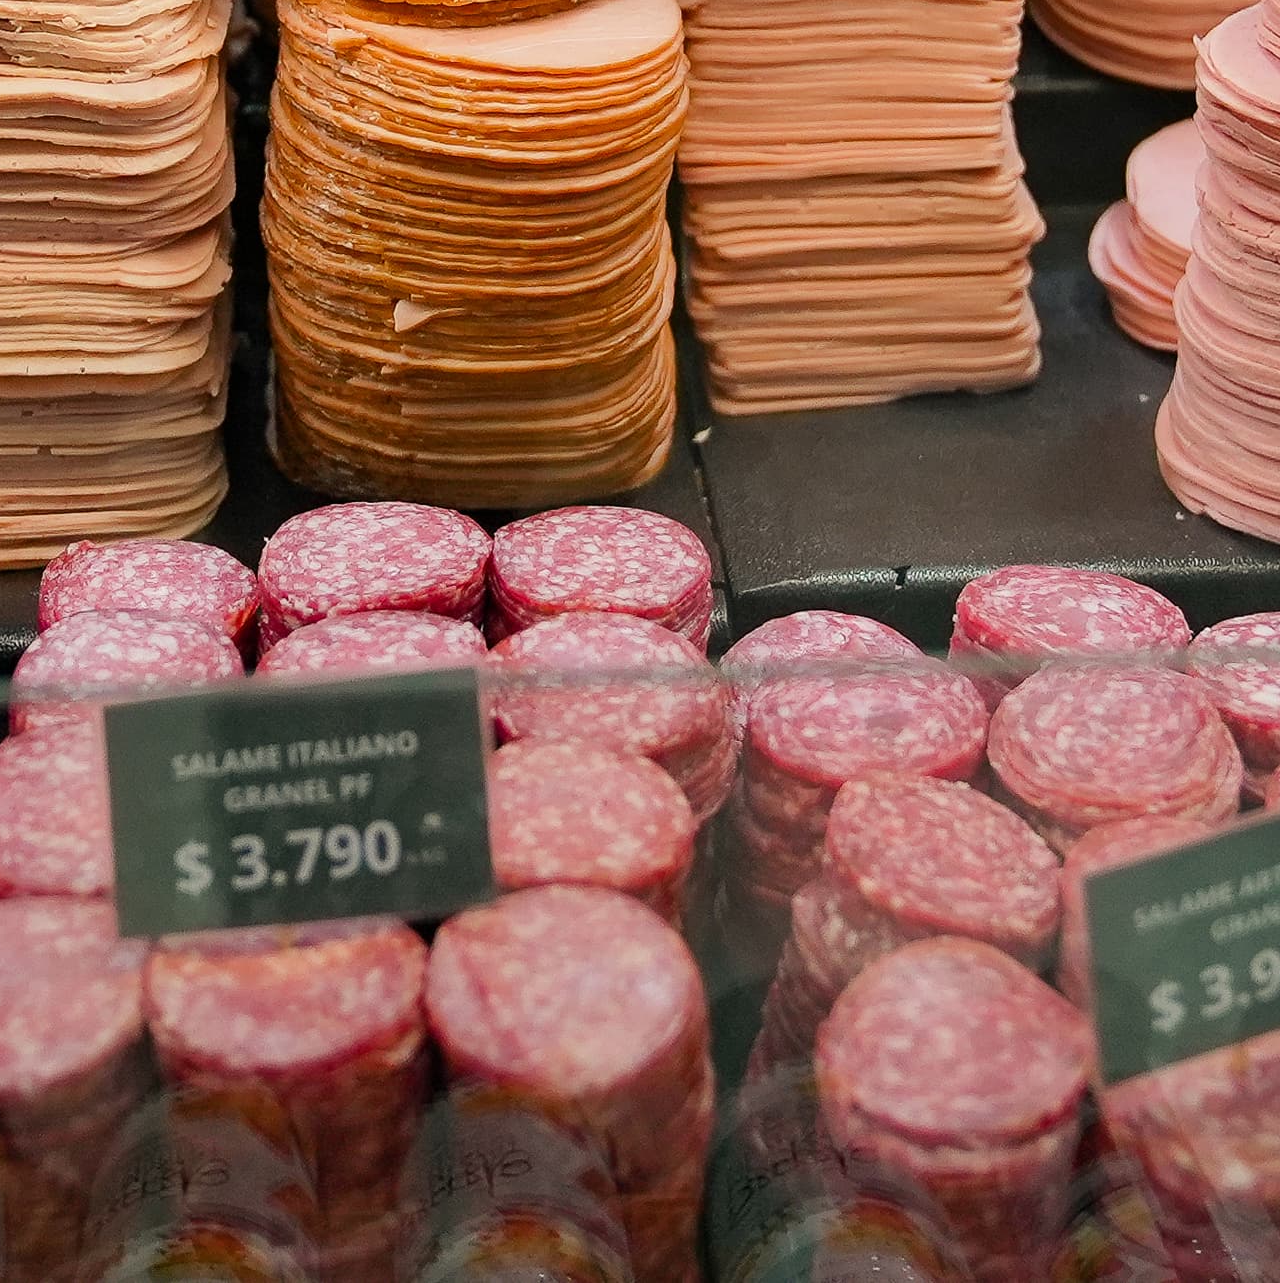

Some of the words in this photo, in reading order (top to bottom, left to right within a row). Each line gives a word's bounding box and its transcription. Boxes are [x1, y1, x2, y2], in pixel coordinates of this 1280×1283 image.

[170, 743, 282, 782] SALAME
[286, 729, 419, 768] ITALIANO
[222, 777, 336, 814] GRANEL
[338, 771, 373, 797] PF
[171, 838, 214, 896] $
[229, 819, 402, 892] 3.790
[1148, 979, 1188, 1035] $
